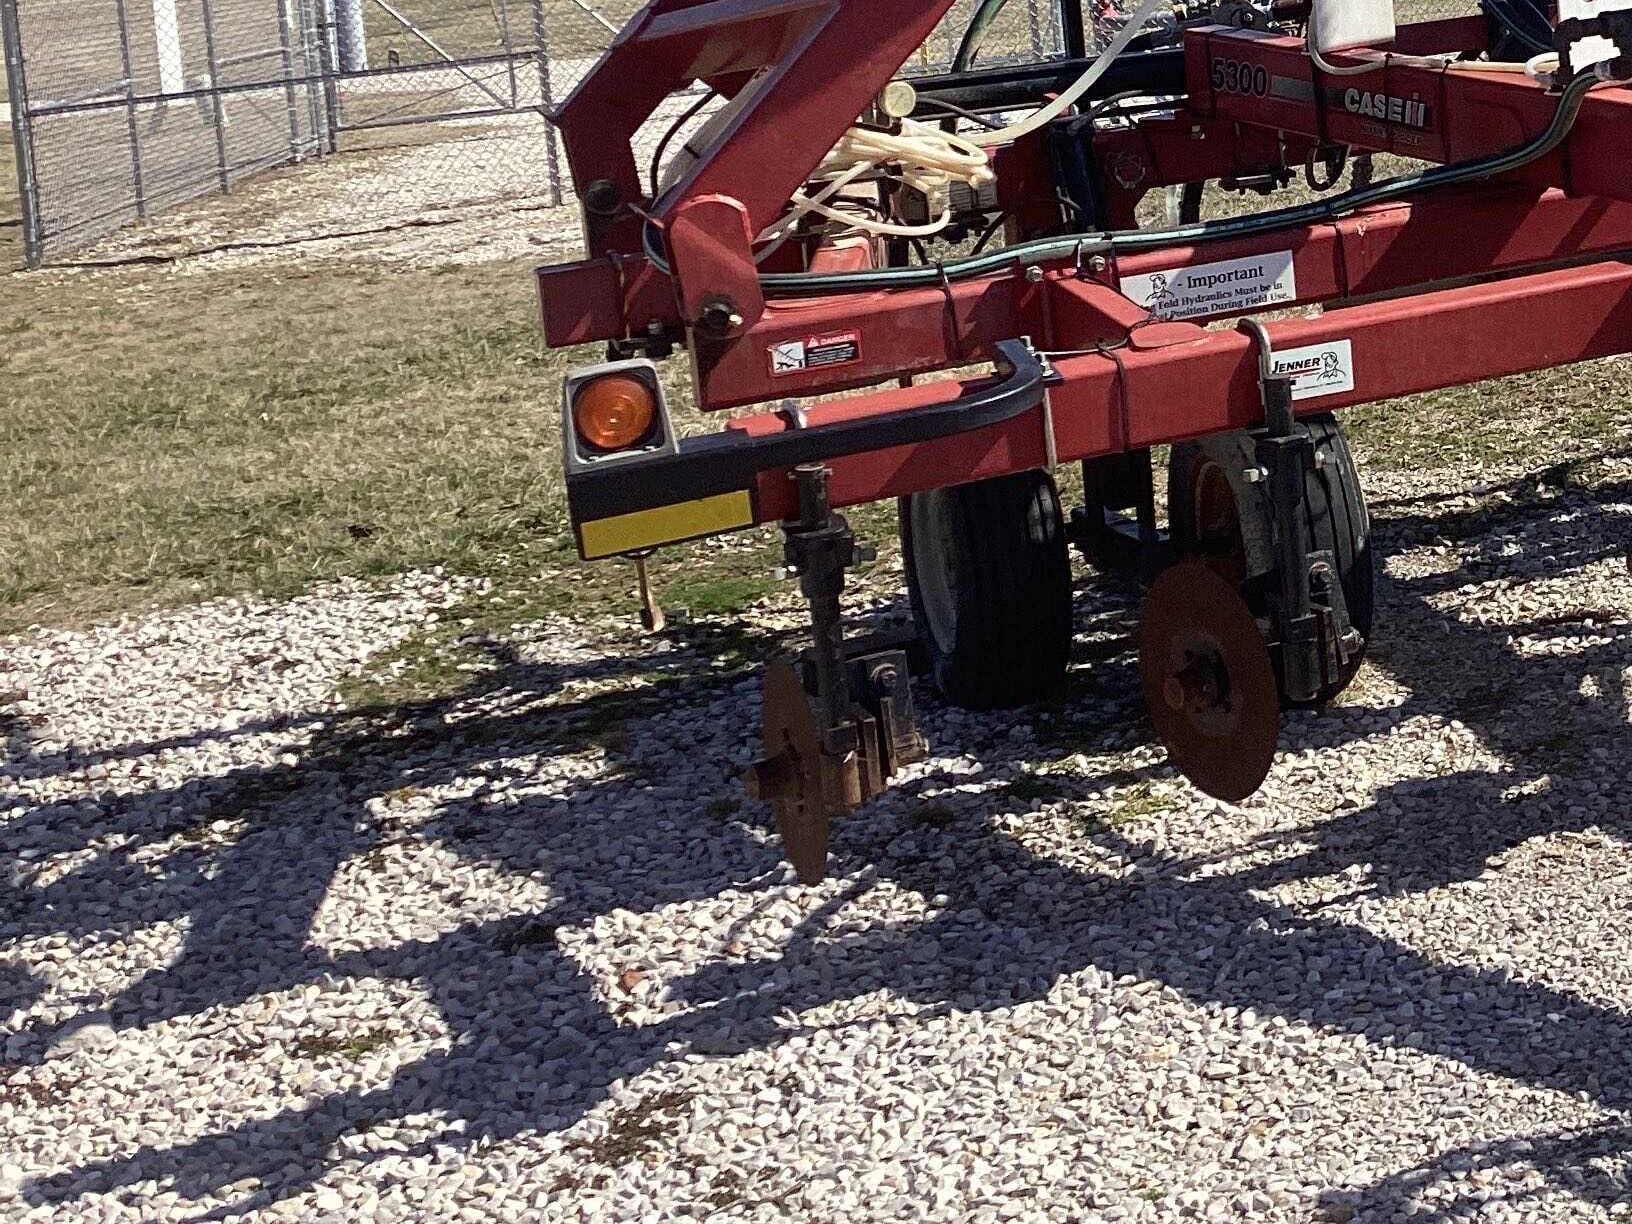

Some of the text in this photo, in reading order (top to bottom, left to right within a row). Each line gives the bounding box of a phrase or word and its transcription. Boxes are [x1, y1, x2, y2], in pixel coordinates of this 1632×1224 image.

[1211, 57, 1268, 97] 5300
[1187, 266, 1264, 289] Important
[1170, 306, 1209, 317] Position
[1211, 299, 1243, 311] During
[1245, 294, 1267, 306] Field
[1181, 290, 1232, 306] Hydraulics
[1234, 286, 1257, 296] Must
[1260, 284, 1271, 292] be
[1272, 357, 1321, 374] JENNER
